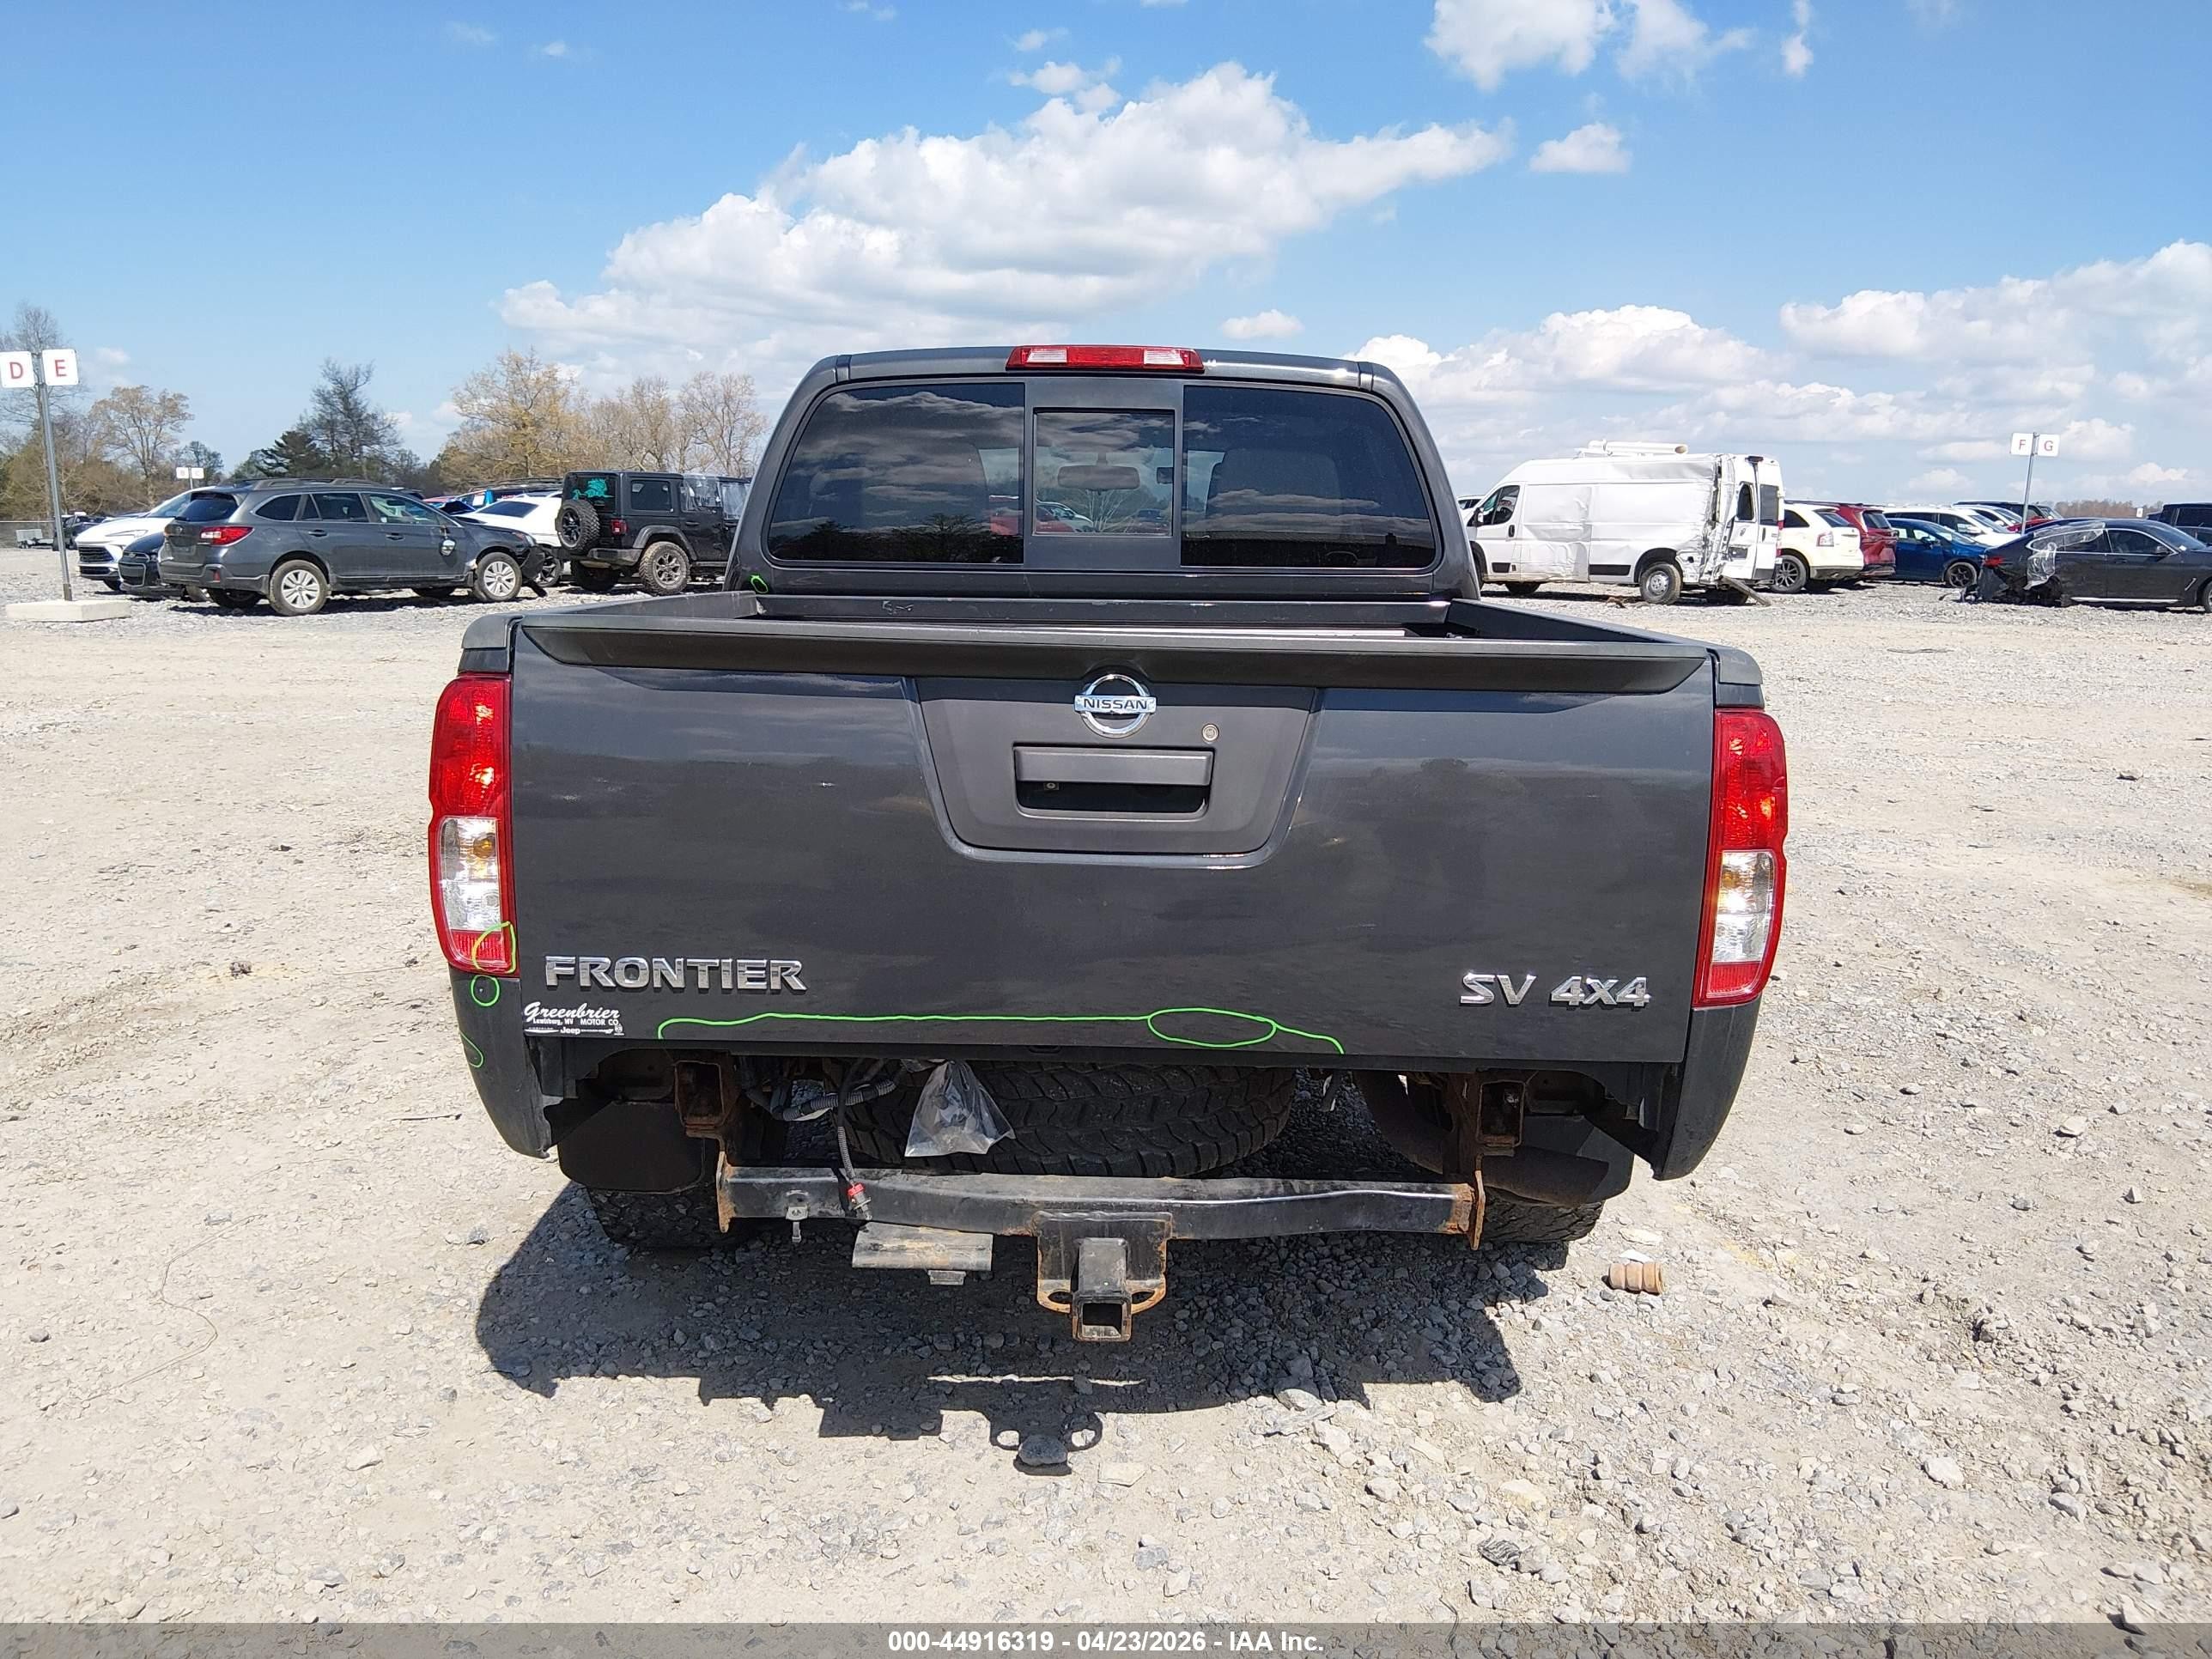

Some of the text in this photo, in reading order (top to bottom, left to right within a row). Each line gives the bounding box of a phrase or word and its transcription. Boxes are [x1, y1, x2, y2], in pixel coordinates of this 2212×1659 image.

[9, 362, 24, 380] D
[54, 359, 67, 378] E
[2019, 439, 2027, 450] F
[2044, 440, 2054, 452] G
[1084, 698, 1147, 710] NISSAN
[545, 955, 807, 992] FRONTIER
[1460, 973, 1537, 1006] SV
[524, 1001, 621, 1023] Greenbrier
[580, 1018, 606, 1026] MOTOR
[560, 1026, 581, 1036] Jeep
